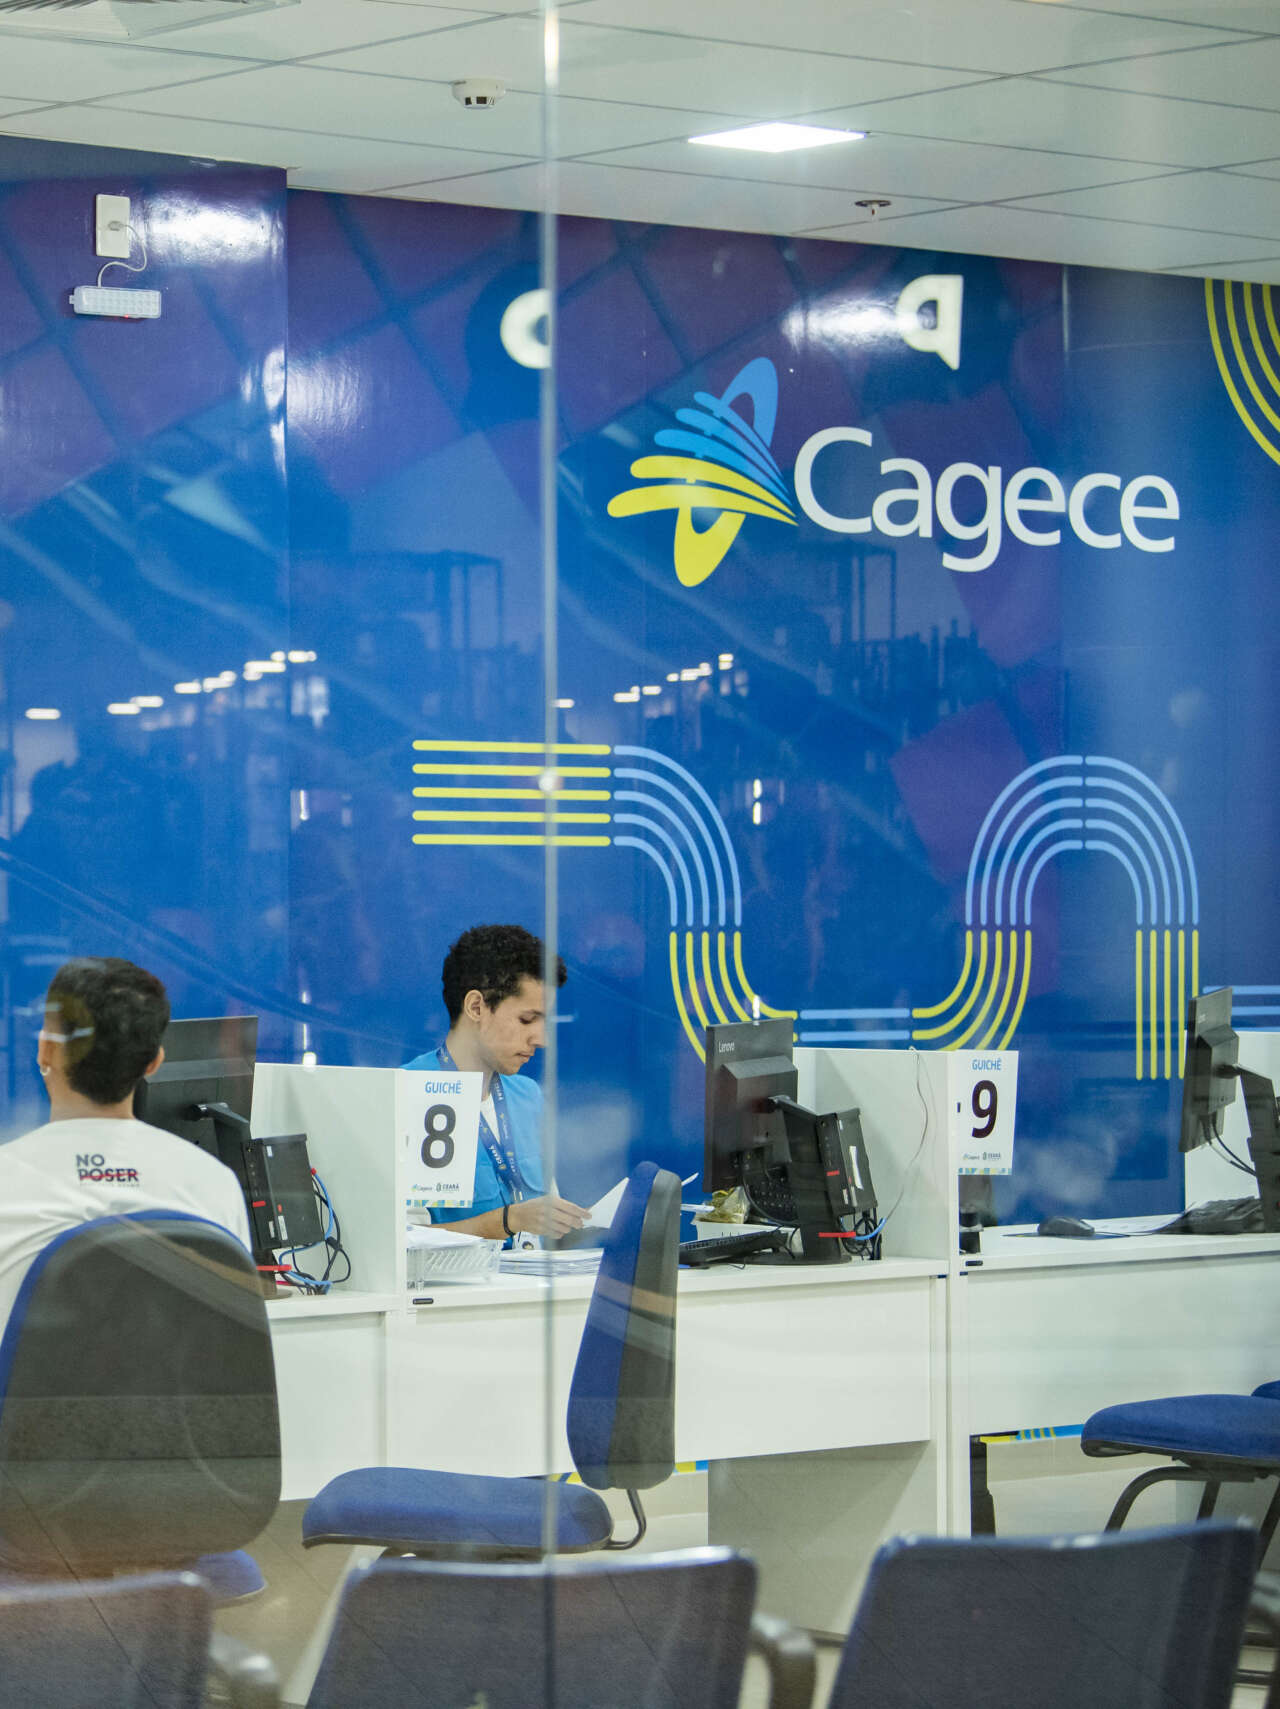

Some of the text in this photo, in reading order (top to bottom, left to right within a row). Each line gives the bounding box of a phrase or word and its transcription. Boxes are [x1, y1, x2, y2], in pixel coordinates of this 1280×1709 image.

[794, 427, 1181, 573] Cagece
[972, 1058, 1002, 1071] GUICHÊ
[424, 1080, 462, 1095] GUICHÊ
[971, 1079, 998, 1139] 9
[420, 1103, 457, 1169] 8
[76, 1153, 105, 1167] NO
[78, 1167, 140, 1182] POSER
